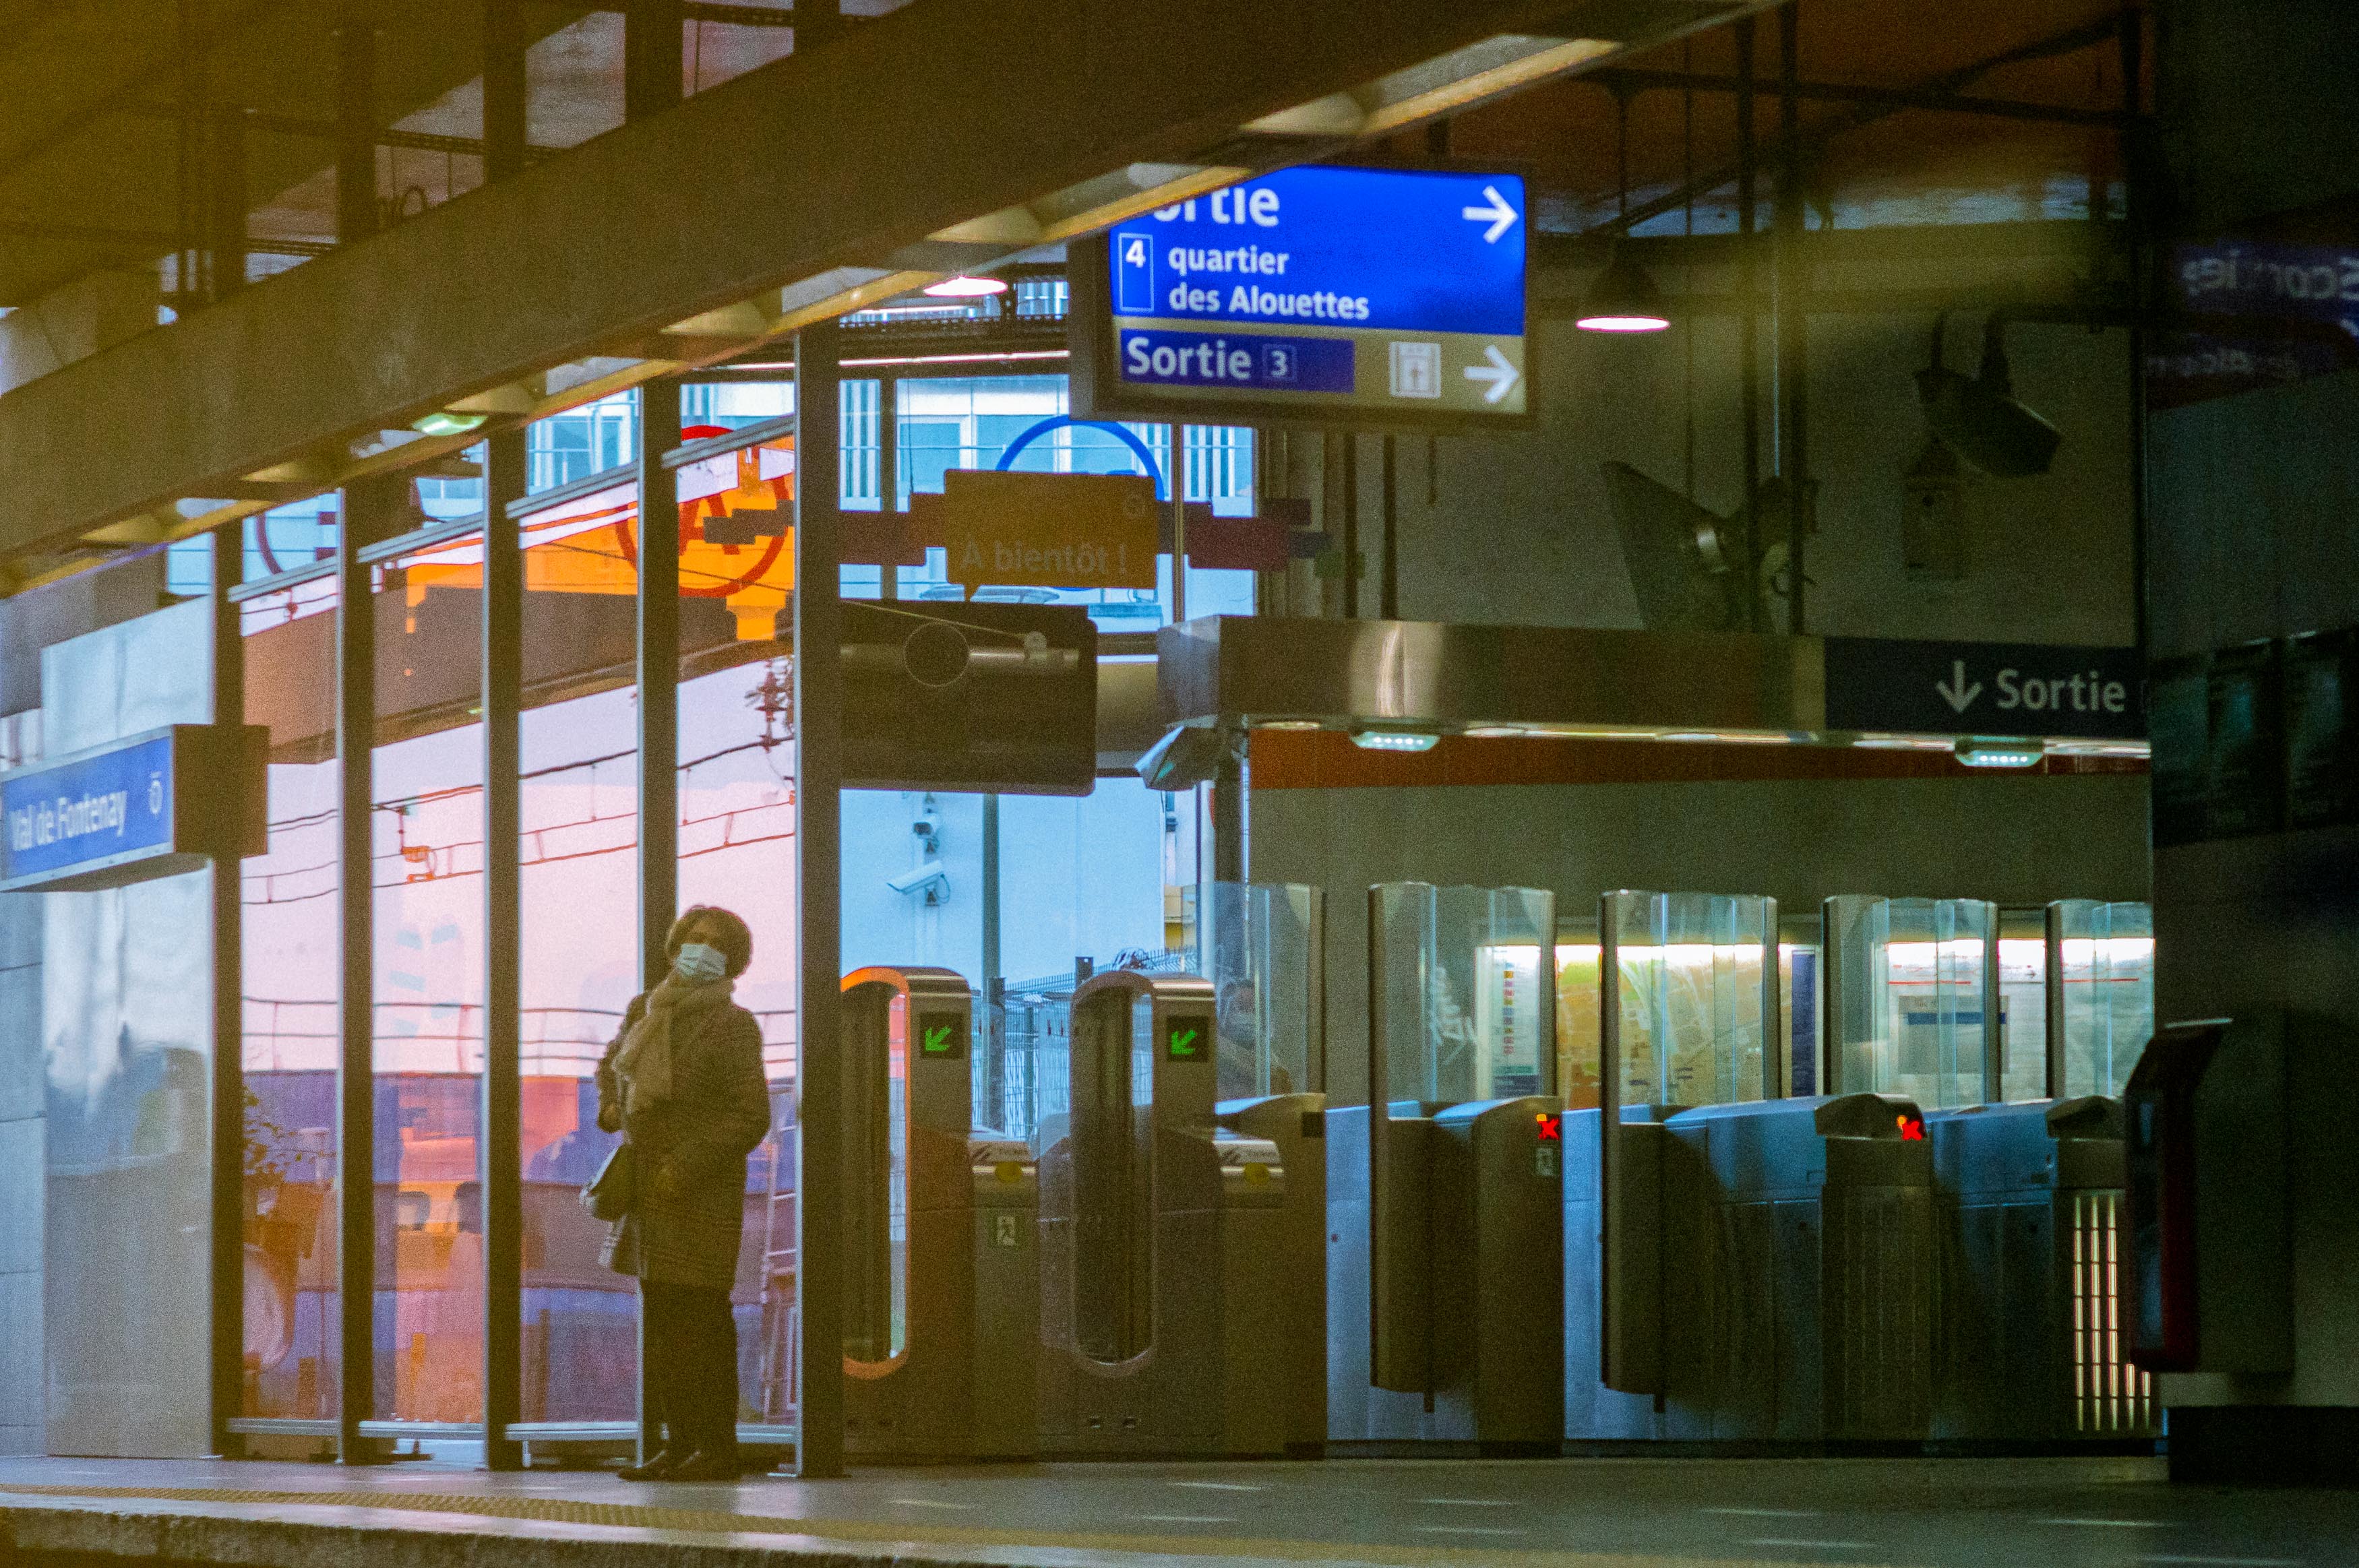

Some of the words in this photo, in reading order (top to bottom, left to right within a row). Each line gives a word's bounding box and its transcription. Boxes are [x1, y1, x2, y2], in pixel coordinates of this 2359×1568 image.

[1125, 239, 1146, 268] 4
[1167, 244, 1290, 277] quartier
[1168, 281, 1221, 313] des
[1228, 284, 1371, 321] Alouettes
[1127, 336, 1253, 380] Sortie
[1271, 350, 1288, 378] 3
[994, 540, 1109, 575] bientôt
[1996, 668, 2126, 713] Sortie
[9, 804, 34, 852] Val
[36, 800, 55, 846] de
[57, 790, 128, 841] Fontenay
